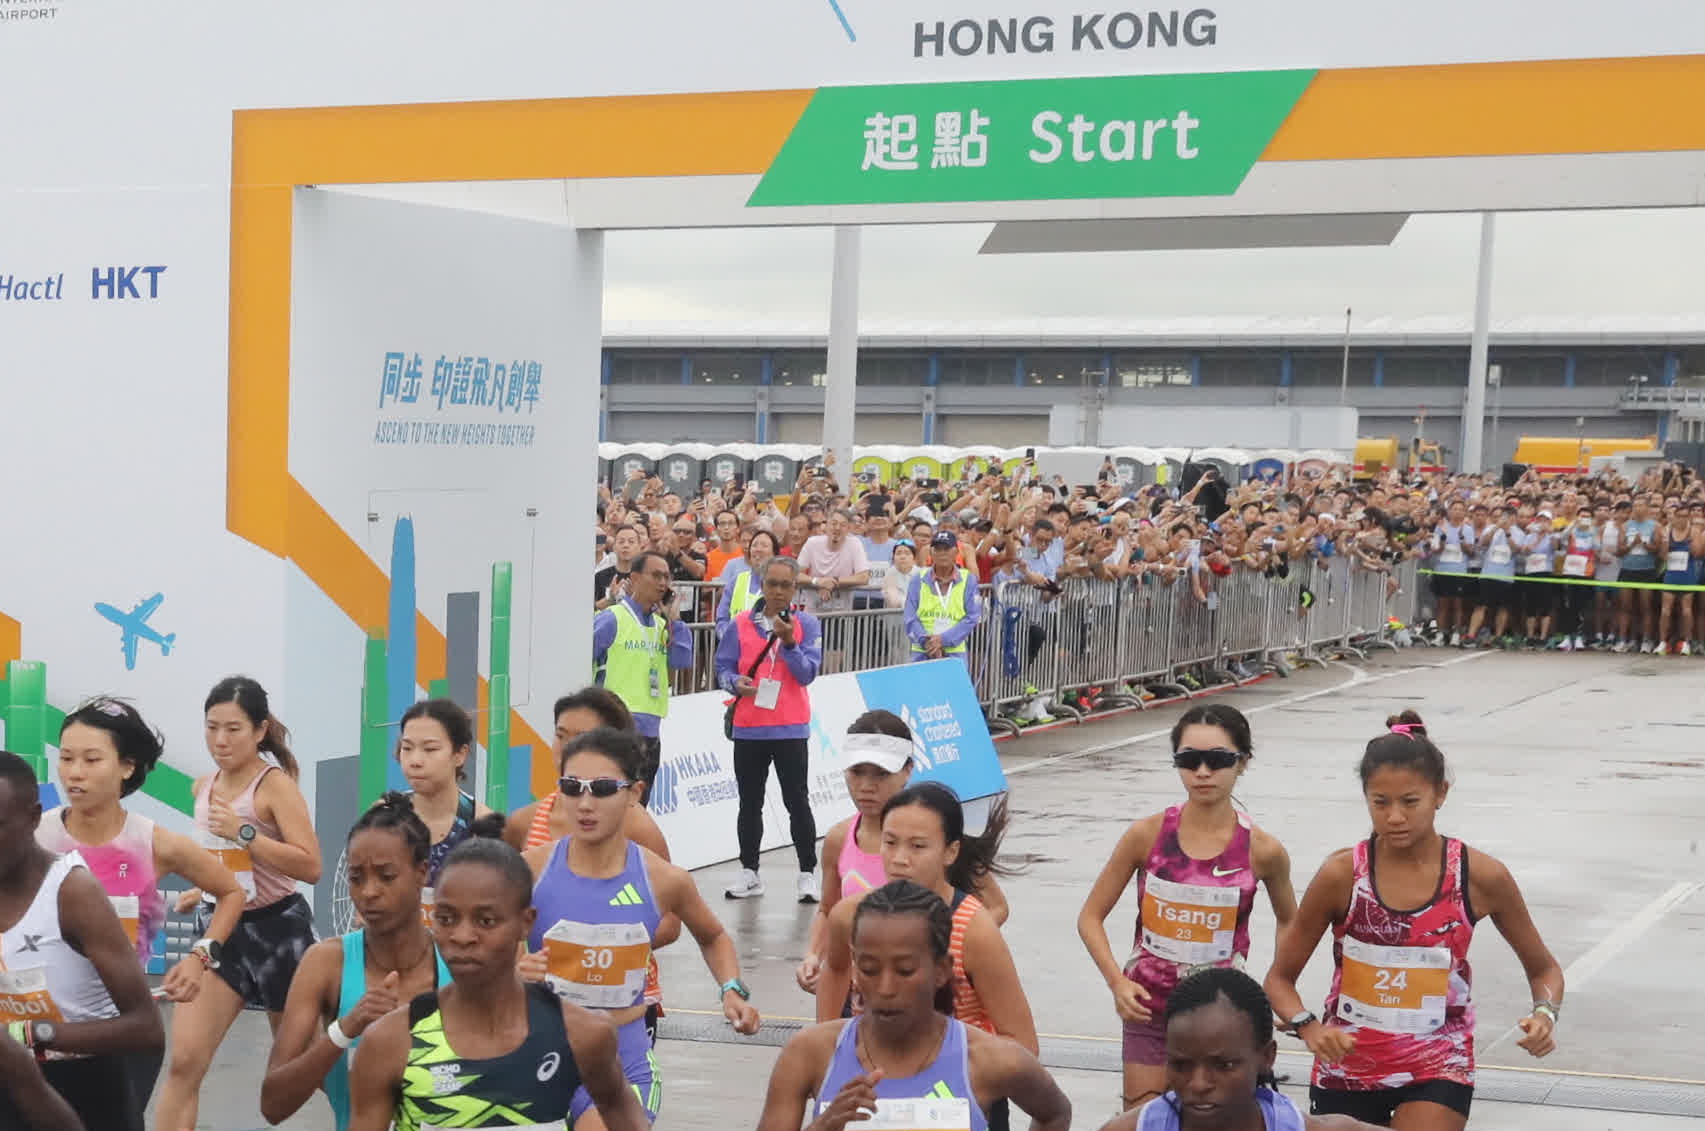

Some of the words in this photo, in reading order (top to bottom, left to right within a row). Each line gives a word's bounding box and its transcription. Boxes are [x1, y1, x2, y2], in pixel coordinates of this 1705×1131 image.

[913, 15, 1055, 57] HONG
[1071, 8, 1217, 51] KONG
[861, 108, 990, 171] 起點
[1028, 109, 1199, 164] Start
[92, 265, 168, 300] HKT
[379, 352, 423, 408] 同步
[1154, 900, 1222, 929] Tsang
[1176, 928, 1192, 940] 23
[581, 948, 613, 969] 30
[1374, 970, 1408, 990] 24
[1377, 993, 1400, 1005] Tan
